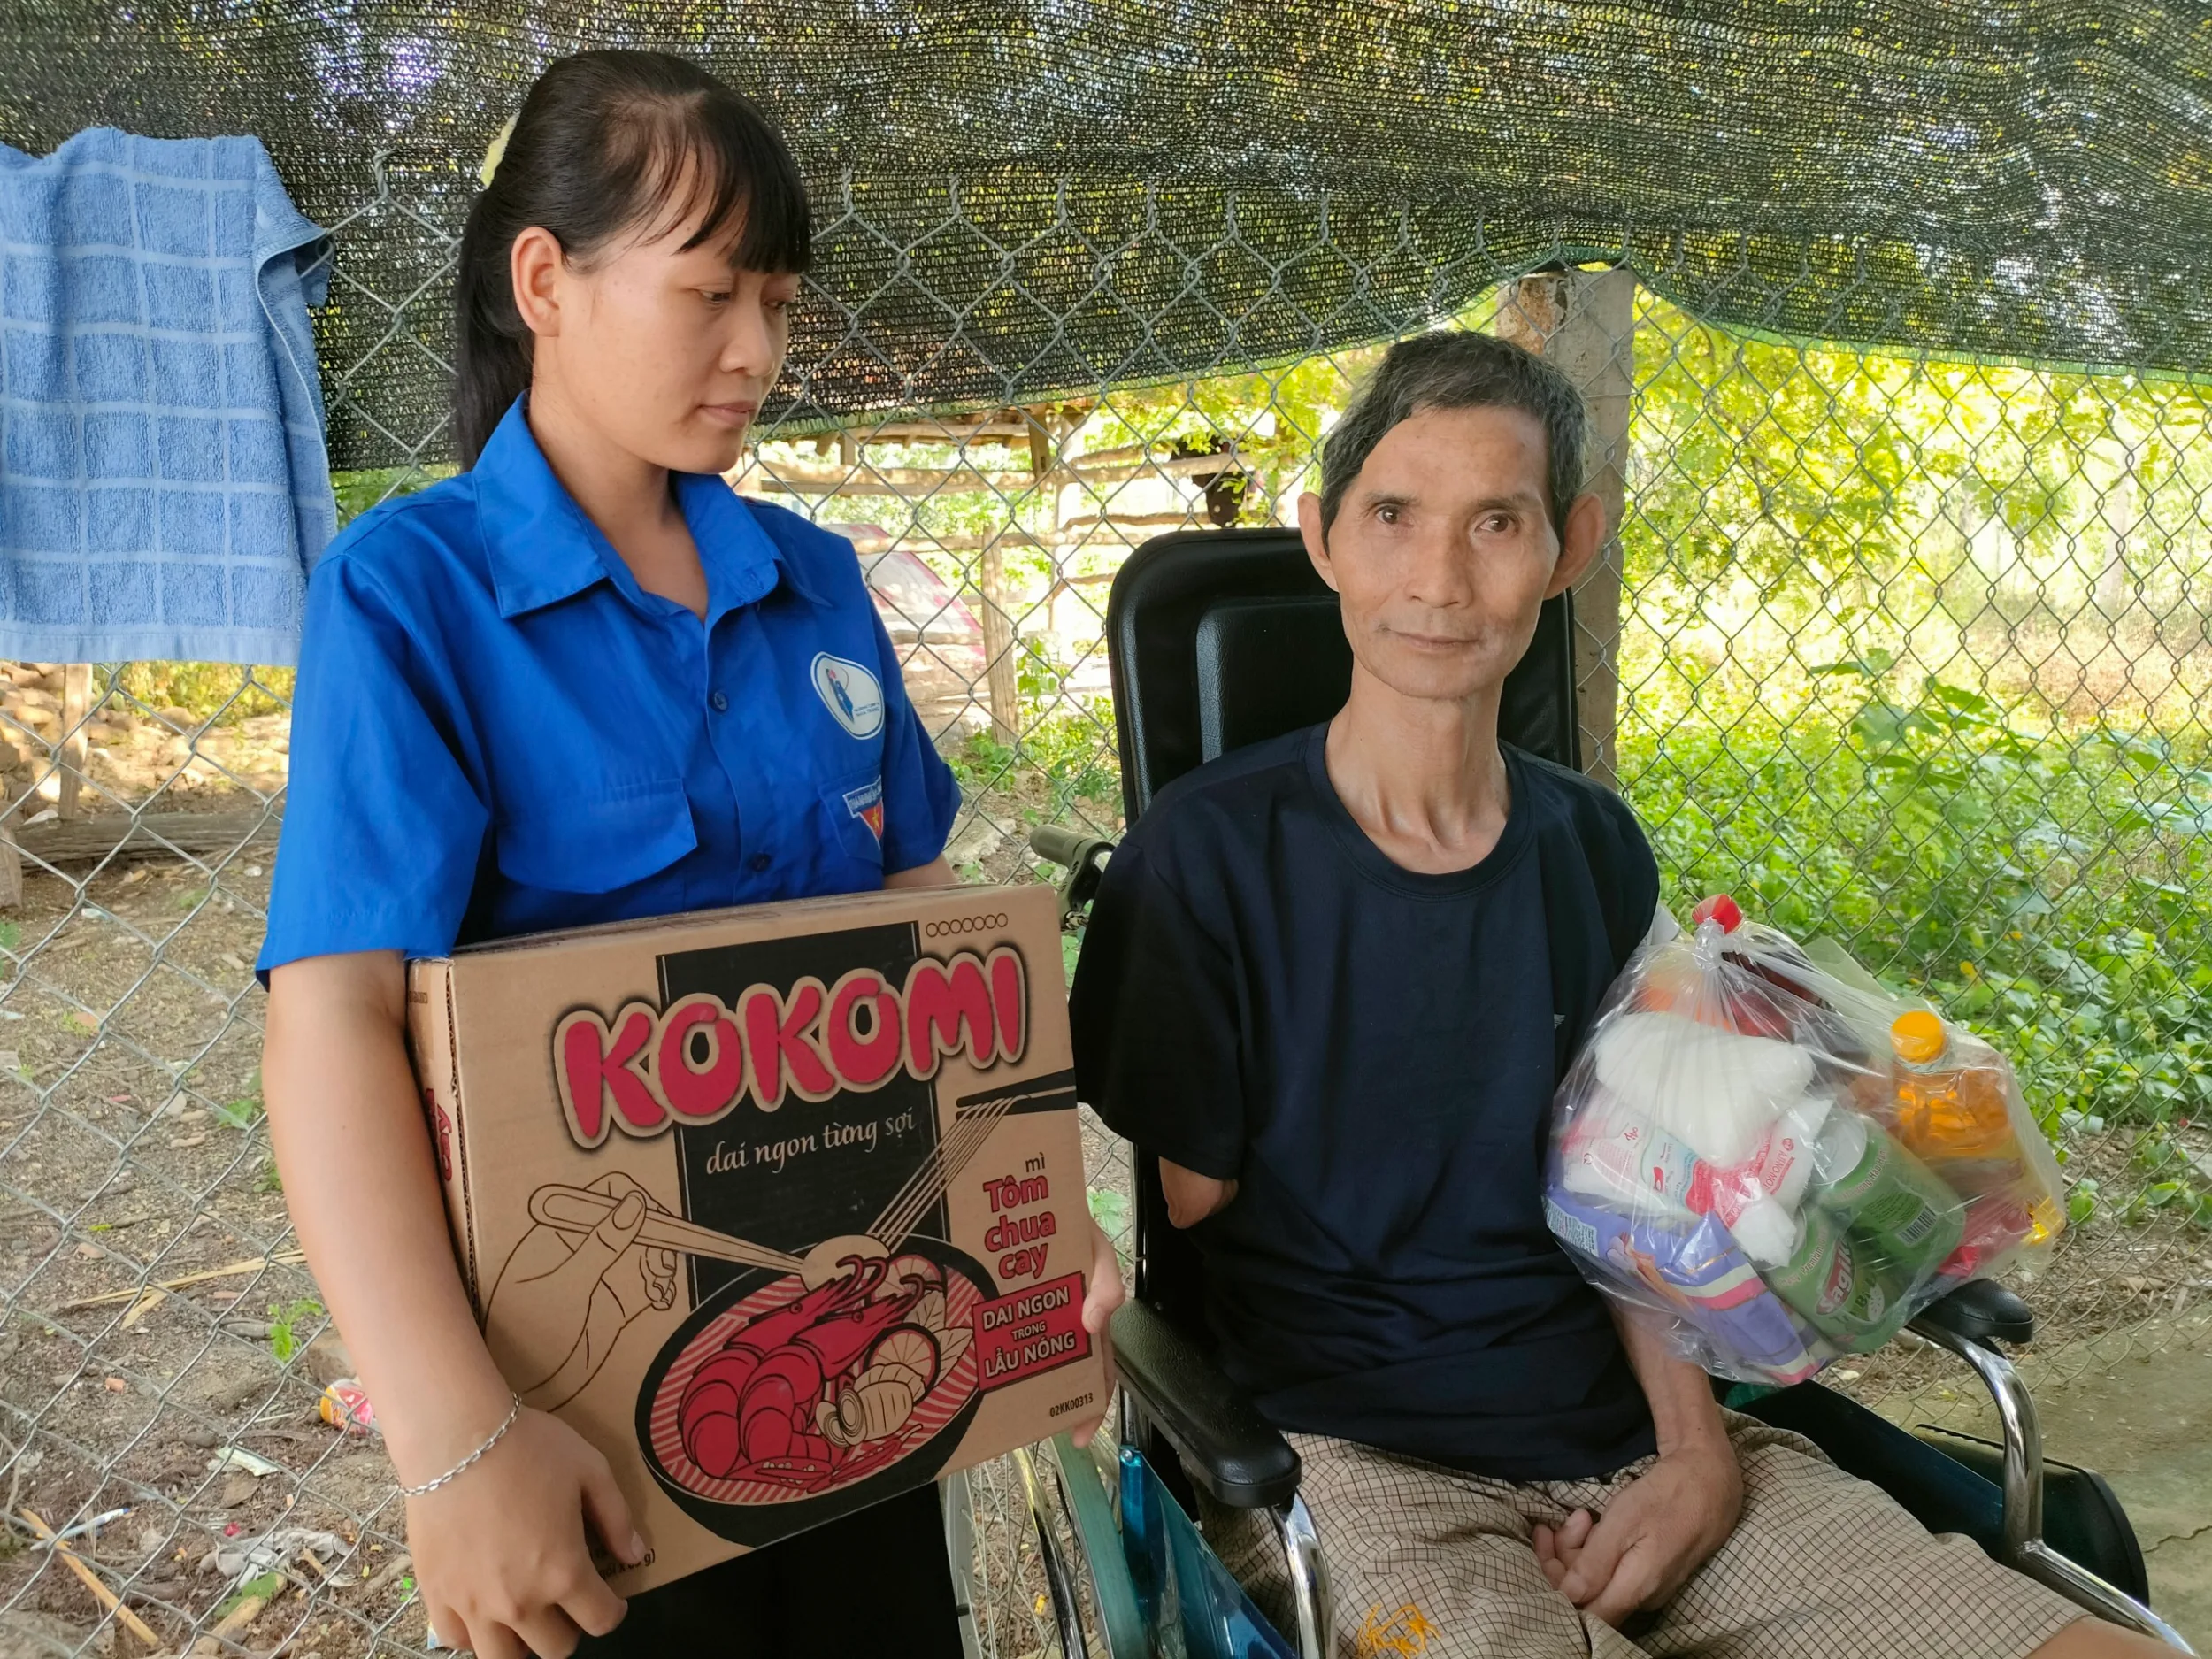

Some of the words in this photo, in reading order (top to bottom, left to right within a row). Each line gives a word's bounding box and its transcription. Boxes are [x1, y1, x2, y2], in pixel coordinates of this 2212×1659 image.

[557, 949, 1025, 1147] KOKOMI
[706, 1141, 749, 1175] dai
[755, 1133, 818, 1175] ngon
[822, 1121, 878, 1154] từng
[885, 1106, 918, 1139] sợi
[1025, 1152, 1046, 1173] mì
[982, 1174, 1049, 1213] Tôm
[984, 1210, 1056, 1253] chua
[998, 1242, 1049, 1280] cay
[1817, 1239, 1853, 1312] Sagik
[982, 1303, 1014, 1331] DAI
[1018, 1285, 1070, 1319] NGON
[1011, 1320, 1047, 1341] TRONG
[984, 1347, 1020, 1379] LẨU
[1023, 1331, 1076, 1365] NÓNG
[1049, 1392, 1094, 1417] 02KK00313
